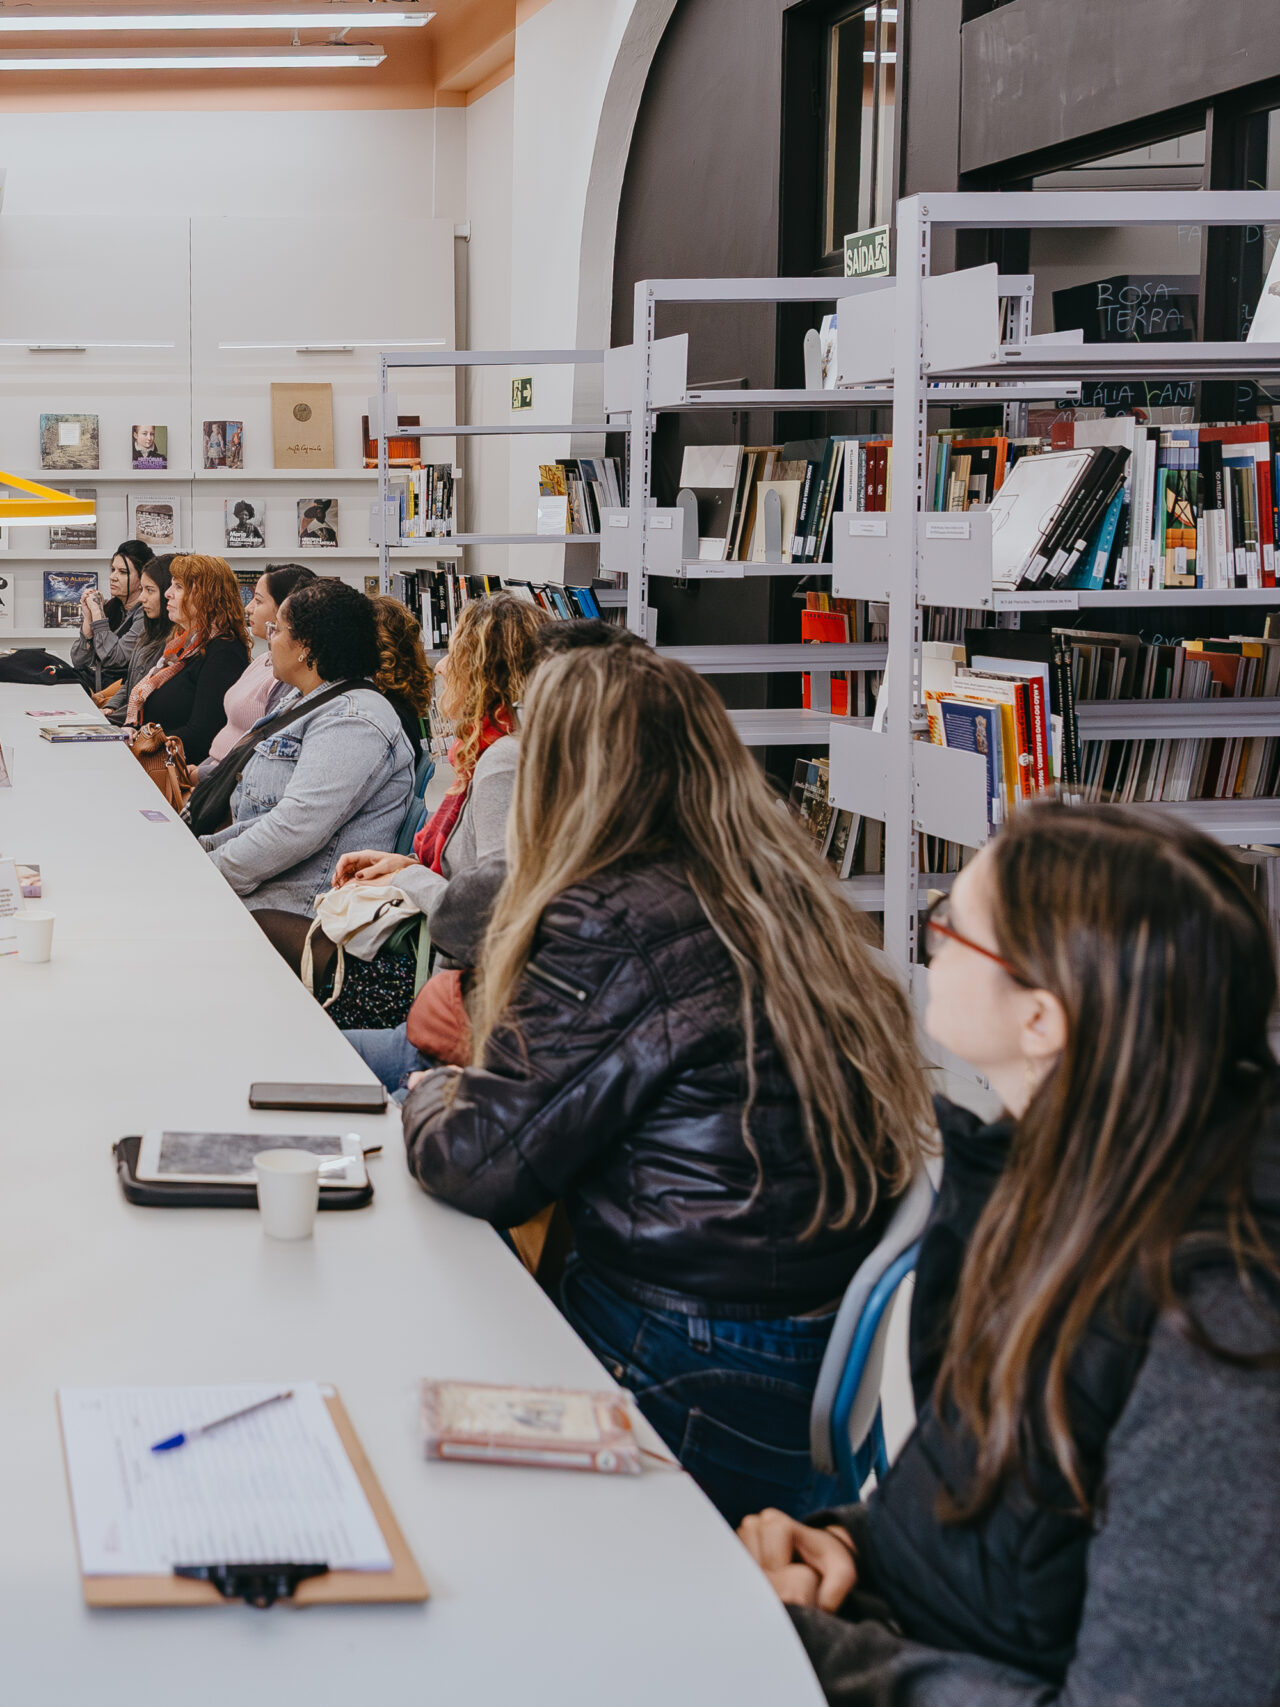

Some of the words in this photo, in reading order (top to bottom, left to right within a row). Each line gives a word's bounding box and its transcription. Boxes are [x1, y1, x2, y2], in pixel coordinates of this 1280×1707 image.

[847, 240, 875, 276] SAÍDA
[1096, 282, 1179, 306] ROSA
[1096, 304, 1184, 335] TERRA
[1216, 472, 1221, 480] DO
[1217, 500, 1222, 509] AO
[1033, 689, 1041, 705] MÃO
[1034, 705, 1040, 715] DO
